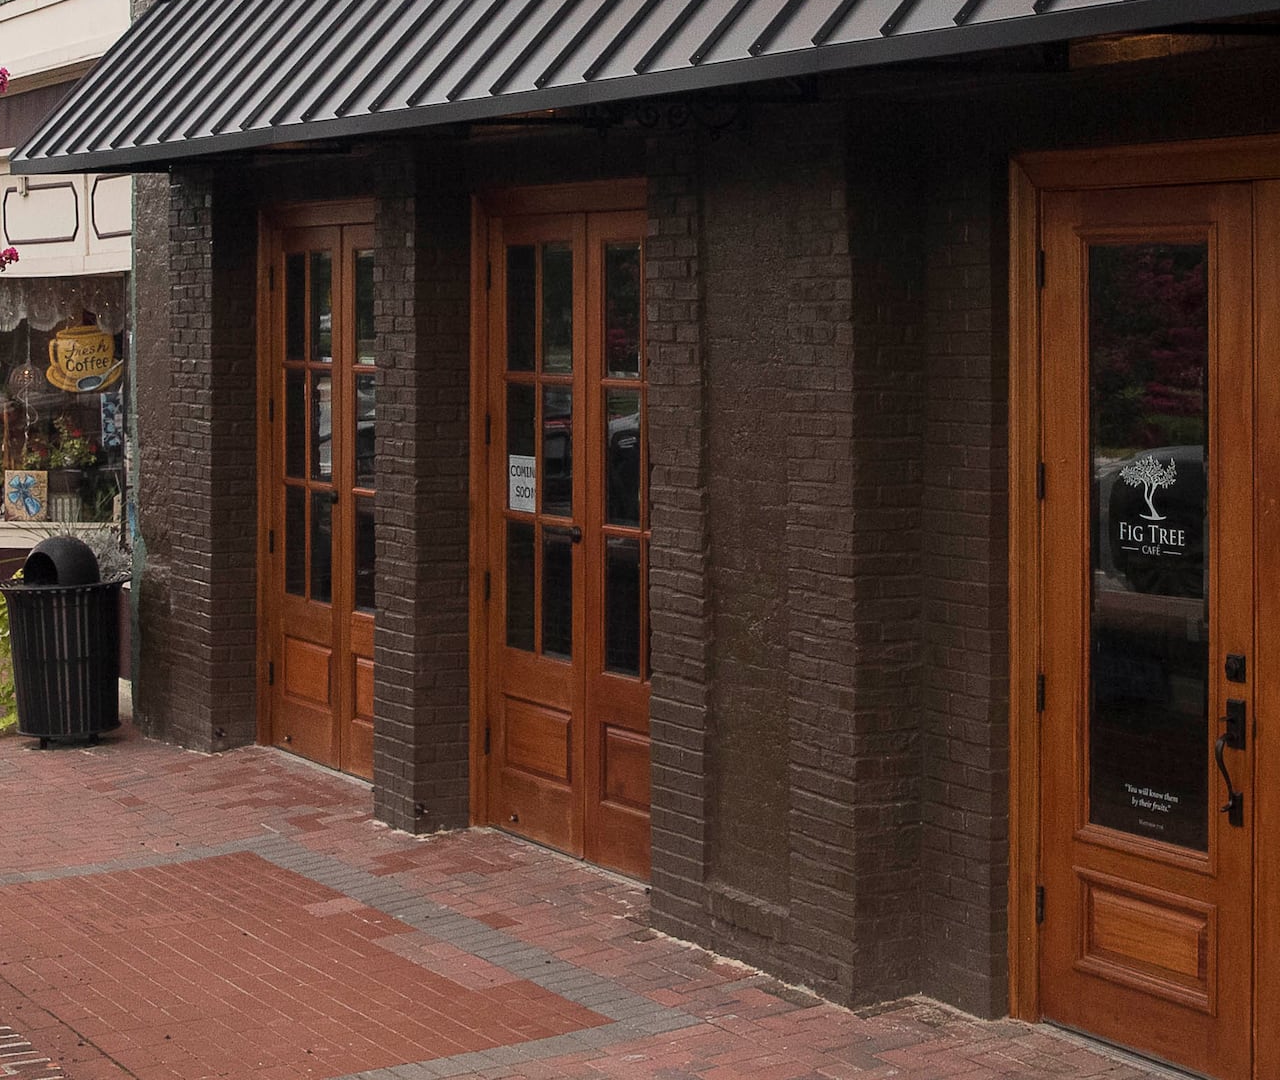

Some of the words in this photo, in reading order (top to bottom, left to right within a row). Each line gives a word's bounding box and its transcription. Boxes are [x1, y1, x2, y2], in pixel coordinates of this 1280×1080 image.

[65, 355, 109, 372] Coffee
[1119, 521, 1144, 542] FIG
[1147, 524, 1186, 547] TREE
[1141, 543, 1162, 556] CAFÉ
